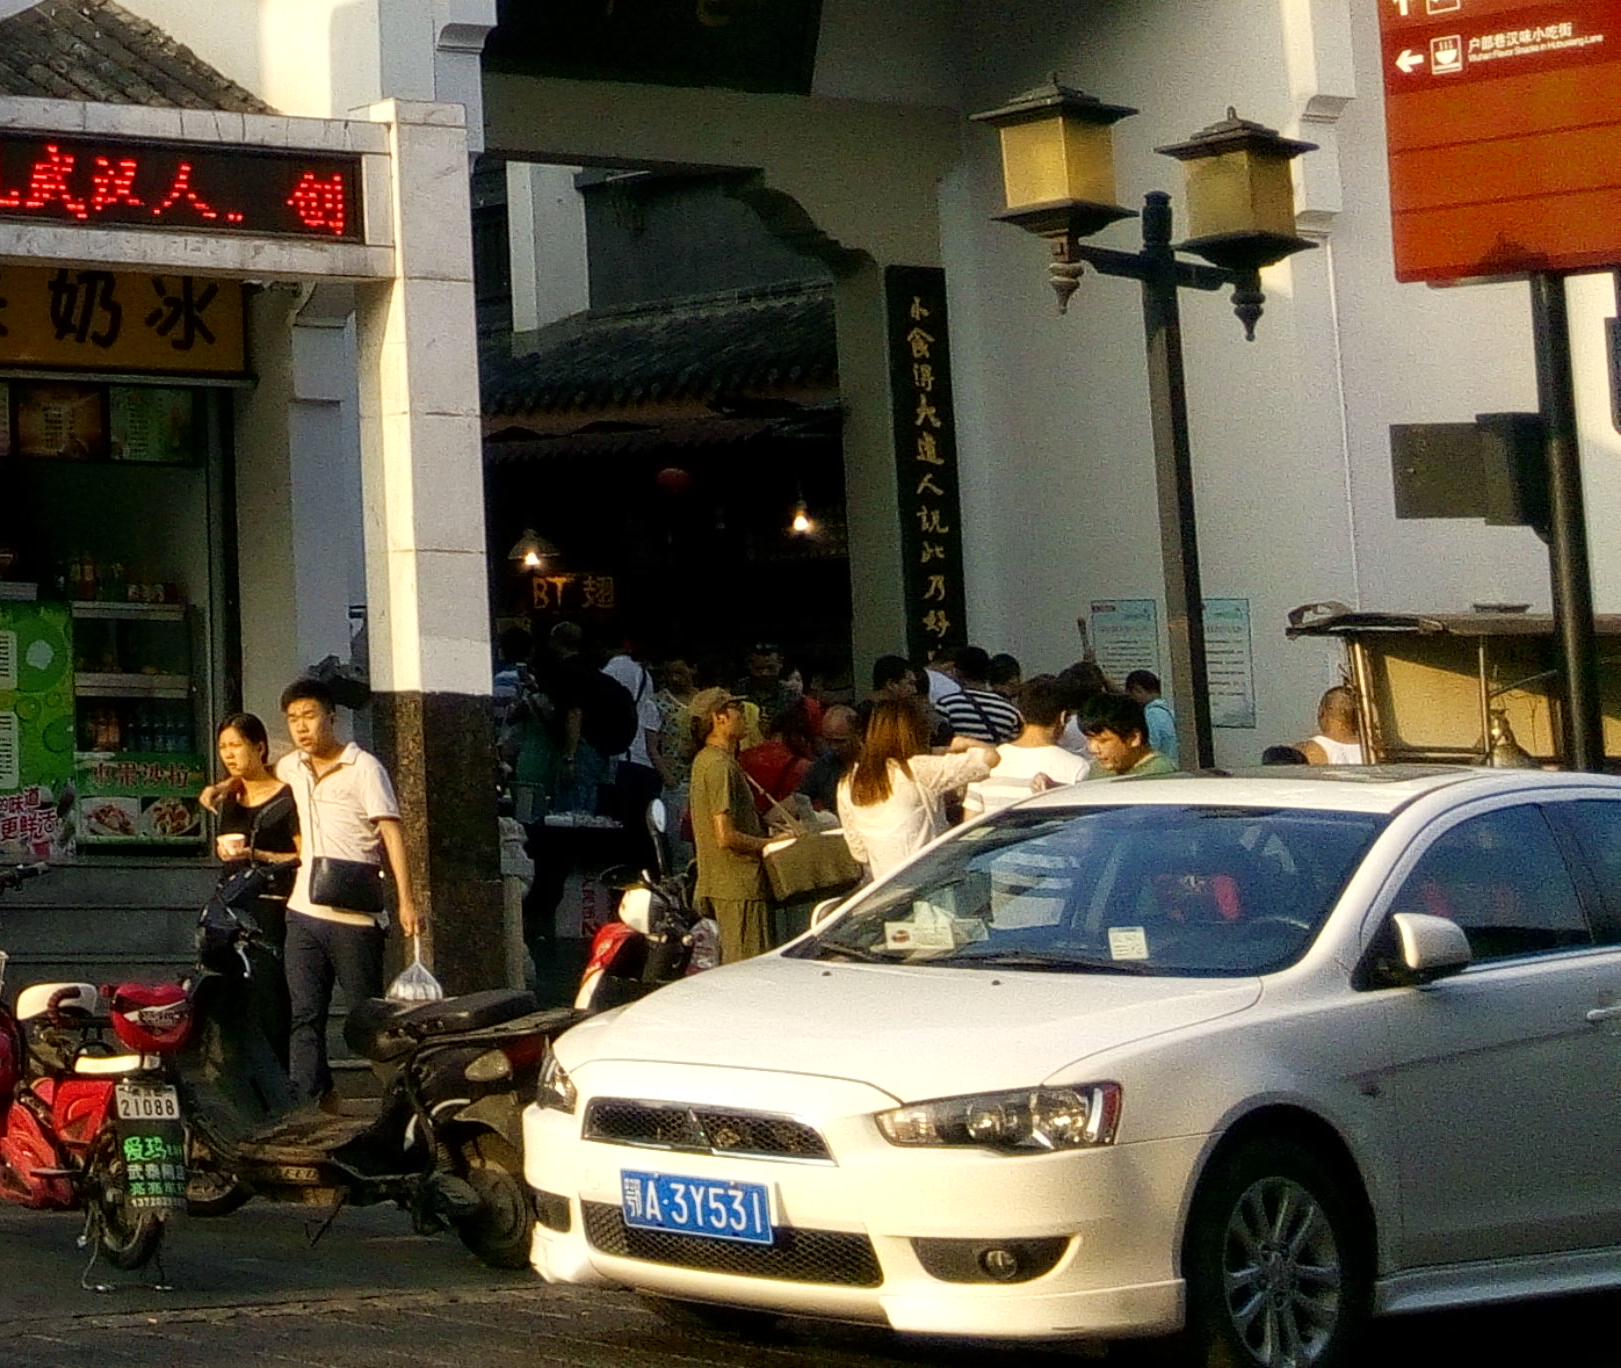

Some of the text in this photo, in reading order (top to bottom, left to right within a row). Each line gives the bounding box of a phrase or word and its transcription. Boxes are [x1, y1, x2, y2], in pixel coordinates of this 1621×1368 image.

[1468, 21, 1573, 53] 户部巷汉味小吃街
[120, 1098, 175, 1117] 21088
